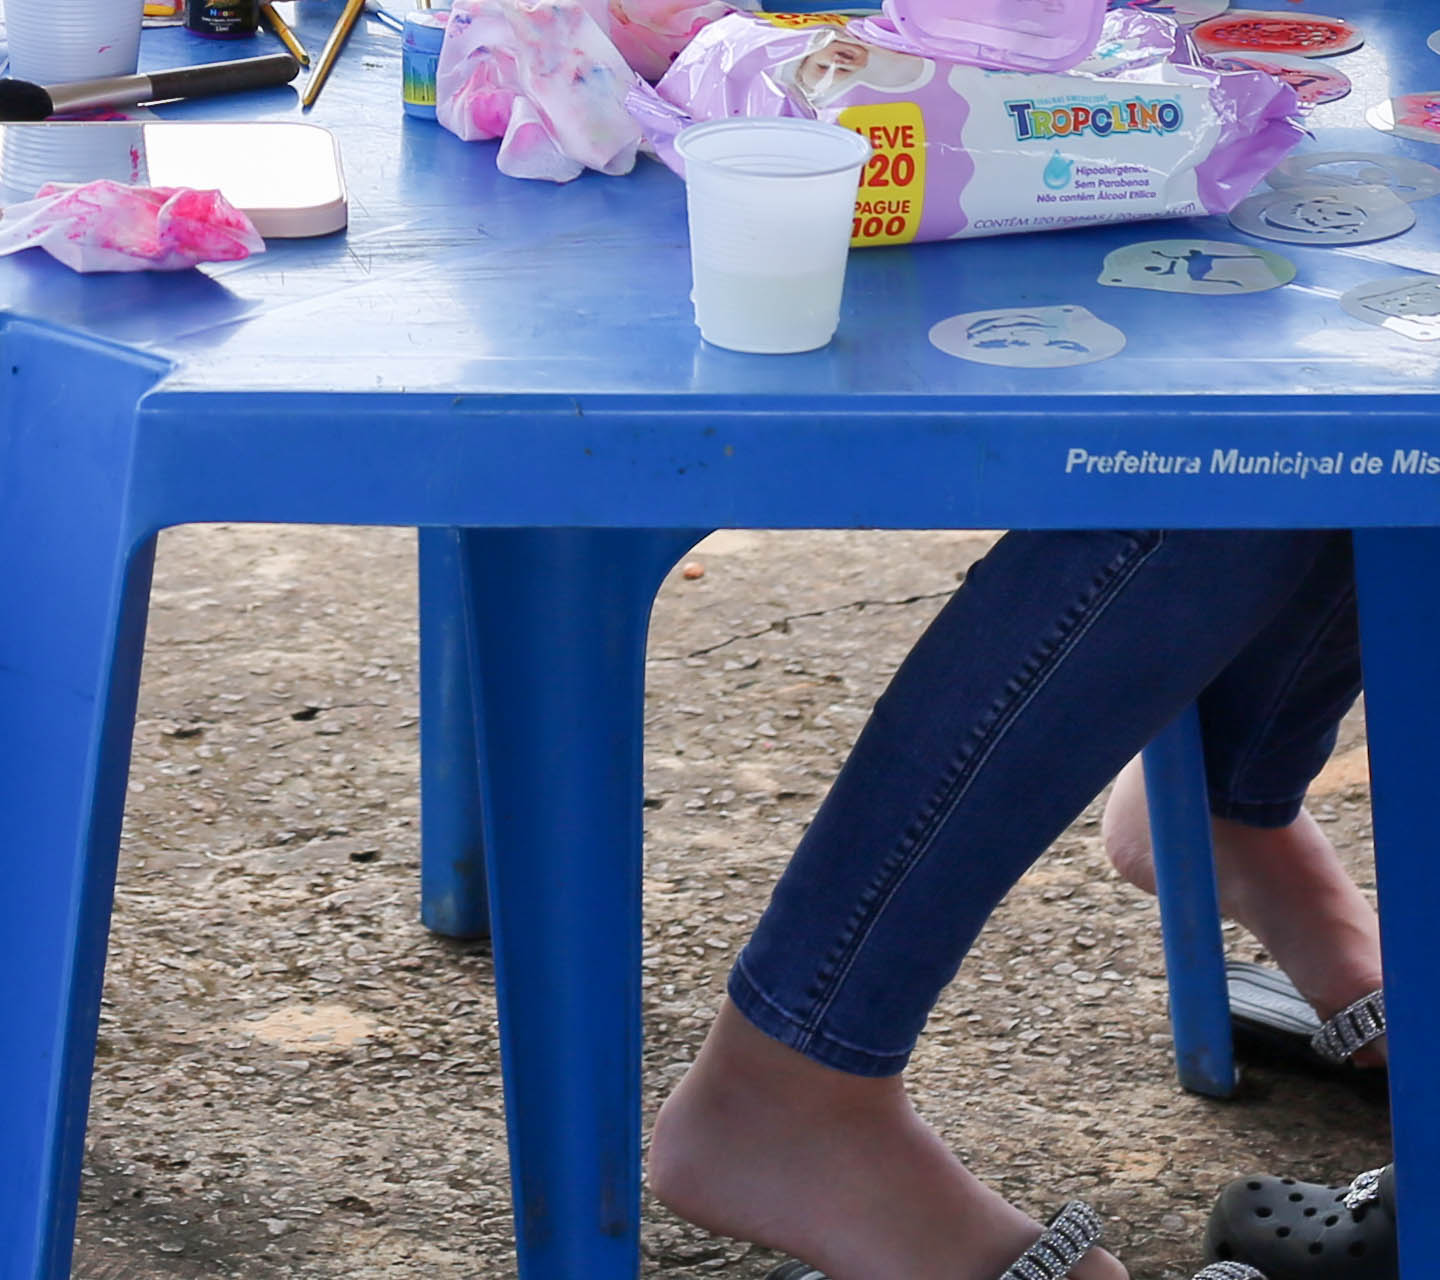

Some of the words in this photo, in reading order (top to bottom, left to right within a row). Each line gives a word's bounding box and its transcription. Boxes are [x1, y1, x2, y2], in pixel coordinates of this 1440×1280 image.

[1007, 101, 1180, 139] TROPOLINO
[1037, 194, 1057, 202] Não
[852, 216, 906, 237] 100
[973, 216, 1030, 230] CONTÉM
[1065, 448, 1201, 475] Prefeitura
[1210, 449, 1342, 479] Municipal
[1350, 452, 1383, 475] de
